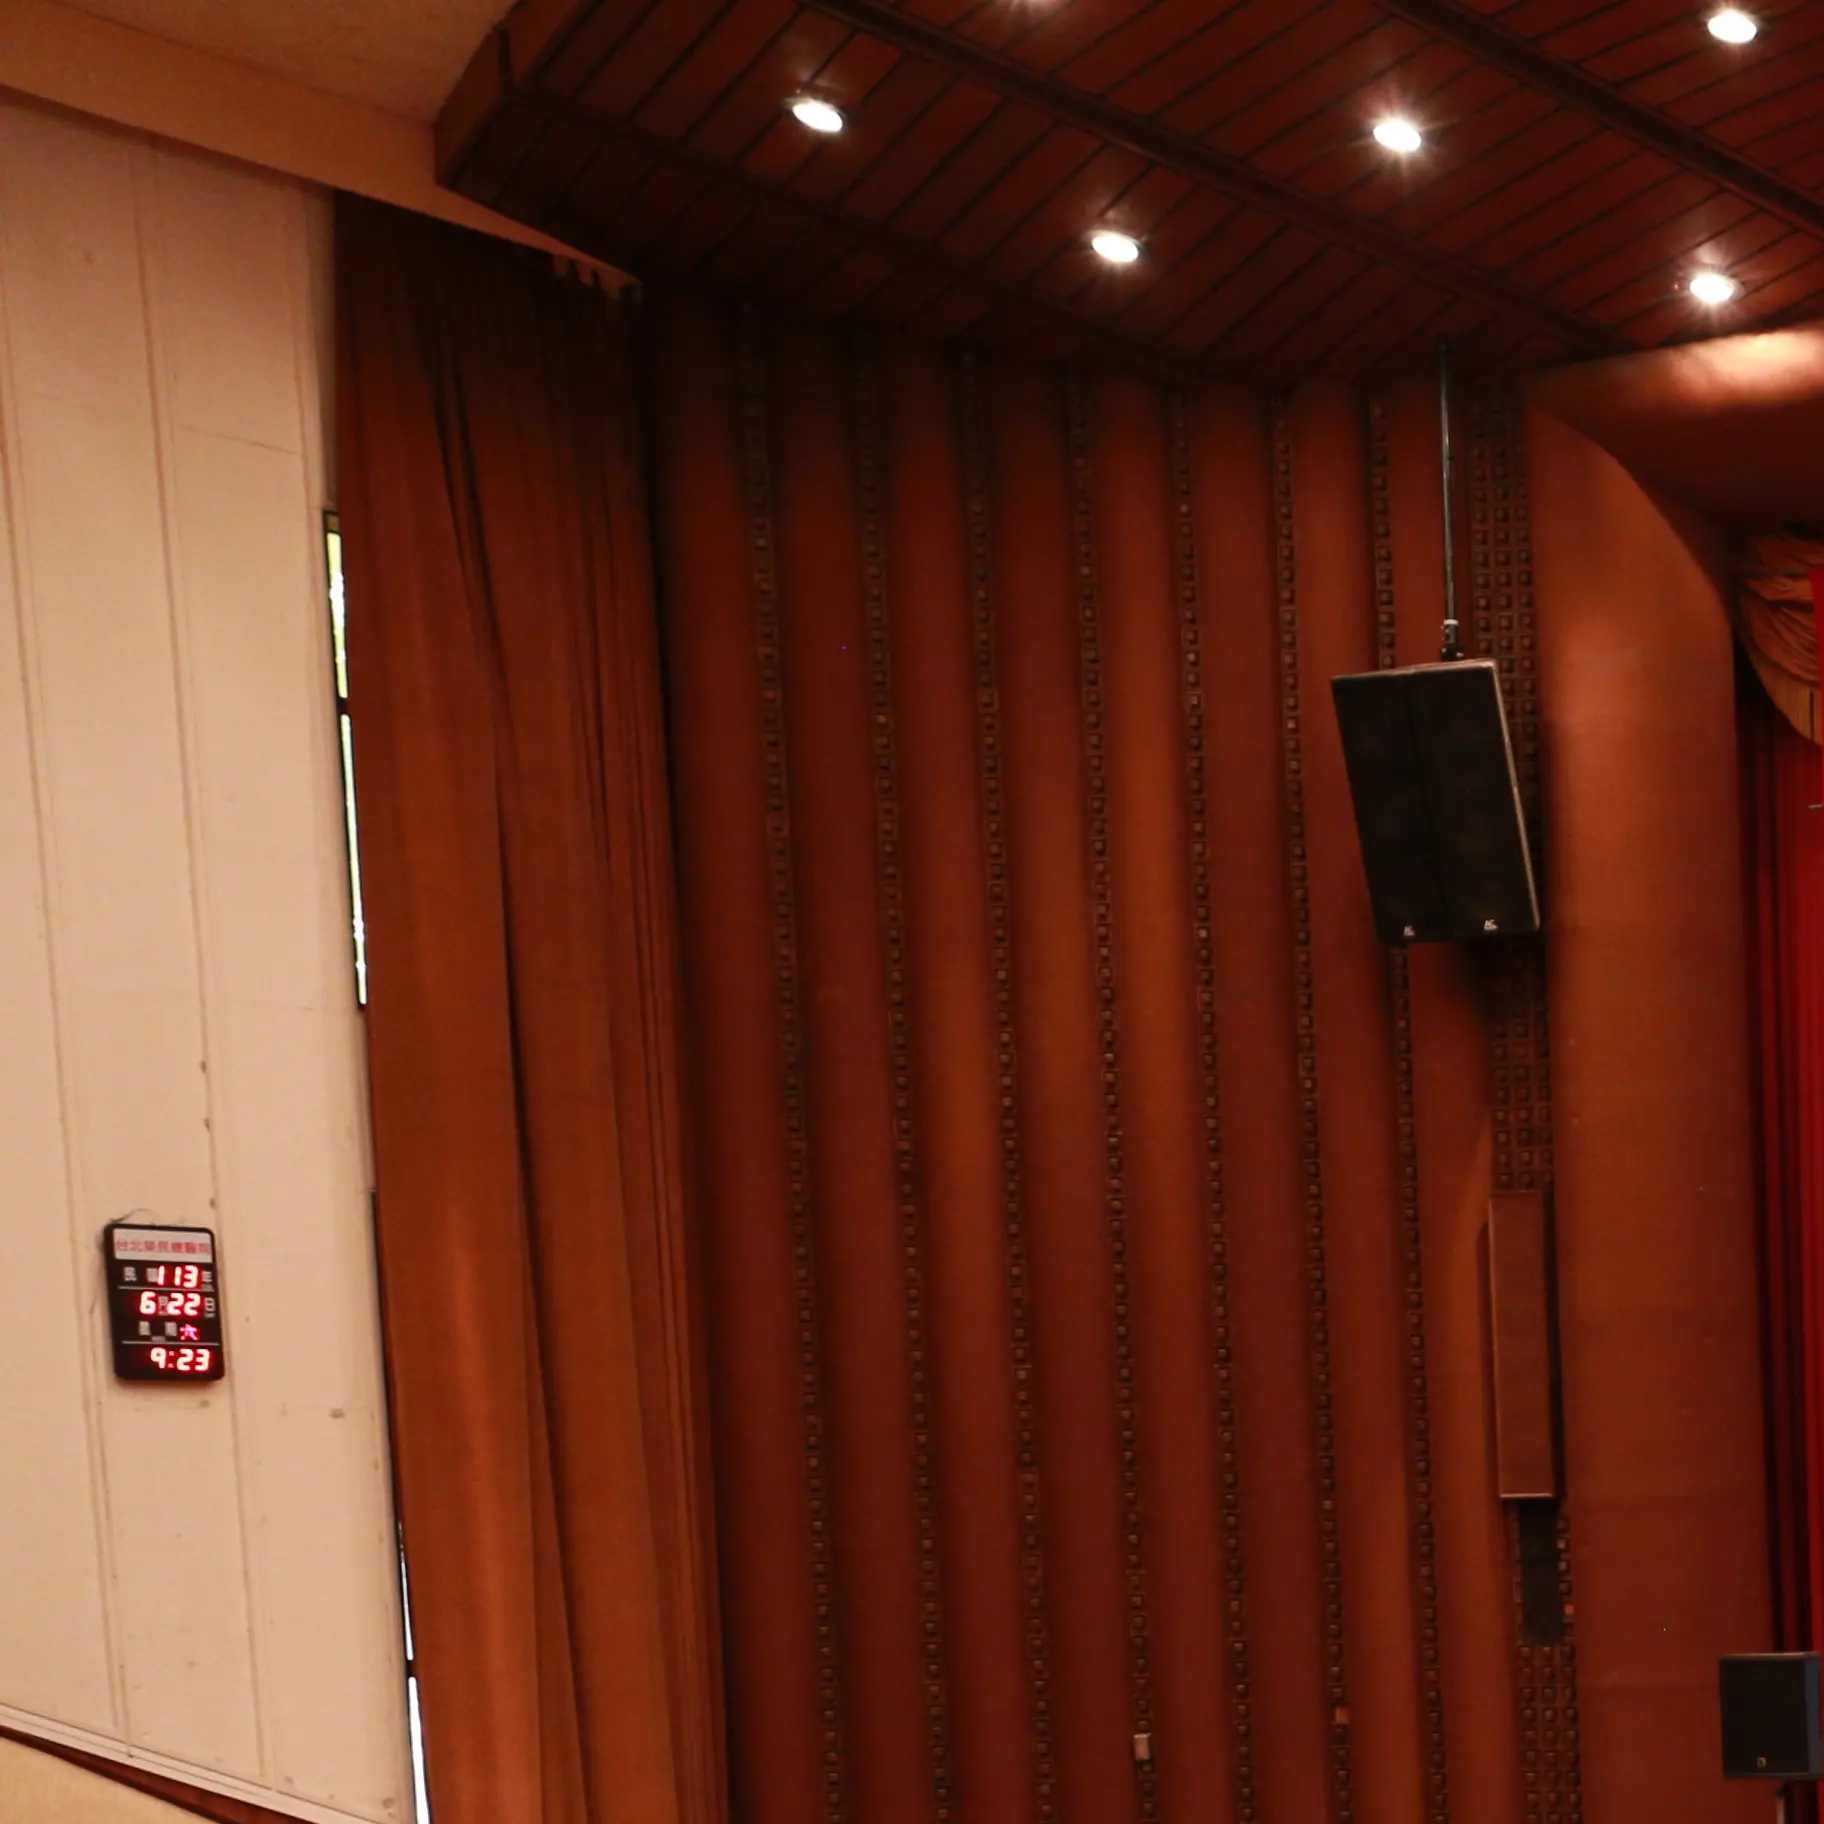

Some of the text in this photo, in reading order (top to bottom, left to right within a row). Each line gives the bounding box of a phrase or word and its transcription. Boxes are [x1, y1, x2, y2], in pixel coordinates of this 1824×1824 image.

[157, 1265, 199, 1289] 113
[140, 1291, 157, 1315] 6
[167, 1292, 201, 1316] 22
[150, 1347, 211, 1371] 9:23
